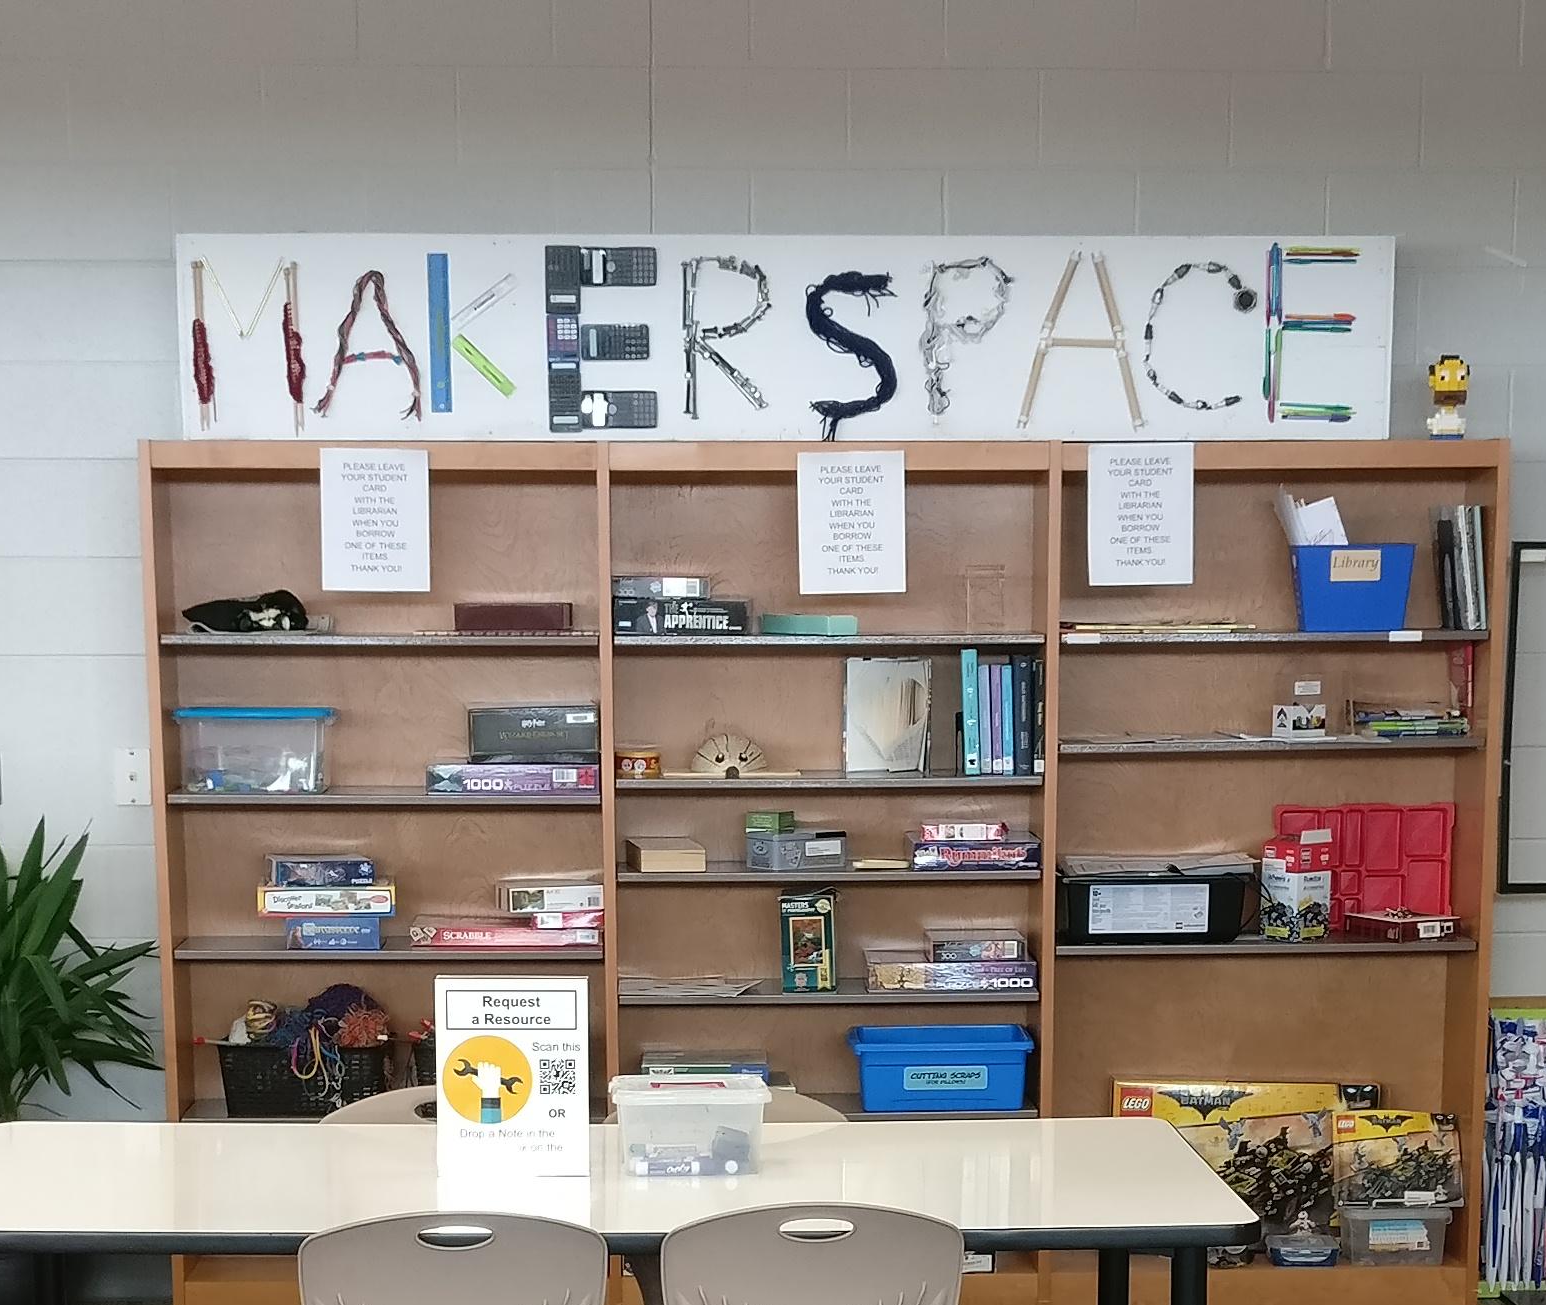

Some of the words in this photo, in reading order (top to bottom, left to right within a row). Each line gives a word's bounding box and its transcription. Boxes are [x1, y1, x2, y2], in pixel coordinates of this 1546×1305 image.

[188, 240, 1365, 442] MAKERSPACE
[1110, 458, 1142, 466] PLEASE
[1145, 458, 1170, 466] LEAVE
[343, 463, 375, 471] PLEASE
[378, 463, 405, 471] LEAVE
[820, 465, 852, 473] PLEASE
[855, 465, 882, 473] LEAVE
[1108, 468, 1132, 477] YOUR
[1135, 468, 1173, 477] STUDENT
[818, 476, 842, 484] YOUR
[845, 476, 884, 484] STUDENT
[1128, 479, 1153, 487] CARD
[362, 484, 387, 492] CARD
[839, 487, 864, 495] CARD
[1121, 491, 1142, 499] WITH
[1145, 491, 1160, 499] THE
[832, 499, 853, 507] WITH
[856, 499, 872, 507] THE
[1118, 502, 1163, 510] LIBRARIAN
[353, 507, 398, 515] LIBRARIAN
[830, 510, 874, 518] LIBRARIAN
[829, 522, 855, 530] WHEN
[857, 522, 875, 530] YOU
[1121, 524, 1159, 532] BORROW
[833, 532, 872, 540] BORROW
[1110, 536, 1128, 544] ONE
[1130, 536, 1141, 544] OF
[1144, 536, 1171, 544] THESE
[345, 542, 362, 550] ONE
[365, 542, 376, 550] OF
[379, 542, 407, 550] THESE
[821, 544, 840, 552] ONE
[842, 544, 853, 552] OF
[856, 544, 883, 552] THESE
[1126, 547, 1152, 555] ITEMS
[1116, 559, 1144, 567] THANK
[1332, 555, 1379, 571] Library
[351, 564, 379, 572] THANK
[828, 567, 856, 575] THANK
[664, 614, 730, 630] APPRENTICE
[463, 779, 504, 791] 1000
[443, 931, 493, 941] SCRABBLE
[991, 977, 1033, 988] 1000
[482, 995, 540, 1010] Request
[471, 1015, 480, 1025] a
[484, 1013, 551, 1025] Resource
[532, 1042, 559, 1052] Scan
[562, 1041, 581, 1052] this
[910, 1072, 947, 1080] CUTTING
[950, 1071, 981, 1079] SCRAPS
[1121, 1096, 1151, 1111] LEGO
[1180, 1096, 1231, 1107] BATMAN
[548, 1109, 566, 1118] OR
[1337, 1120, 1354, 1129] LEGO
[460, 1128, 485, 1139] Drop
[498, 1129, 523, 1138] Note
[539, 1128, 555, 1138] the
